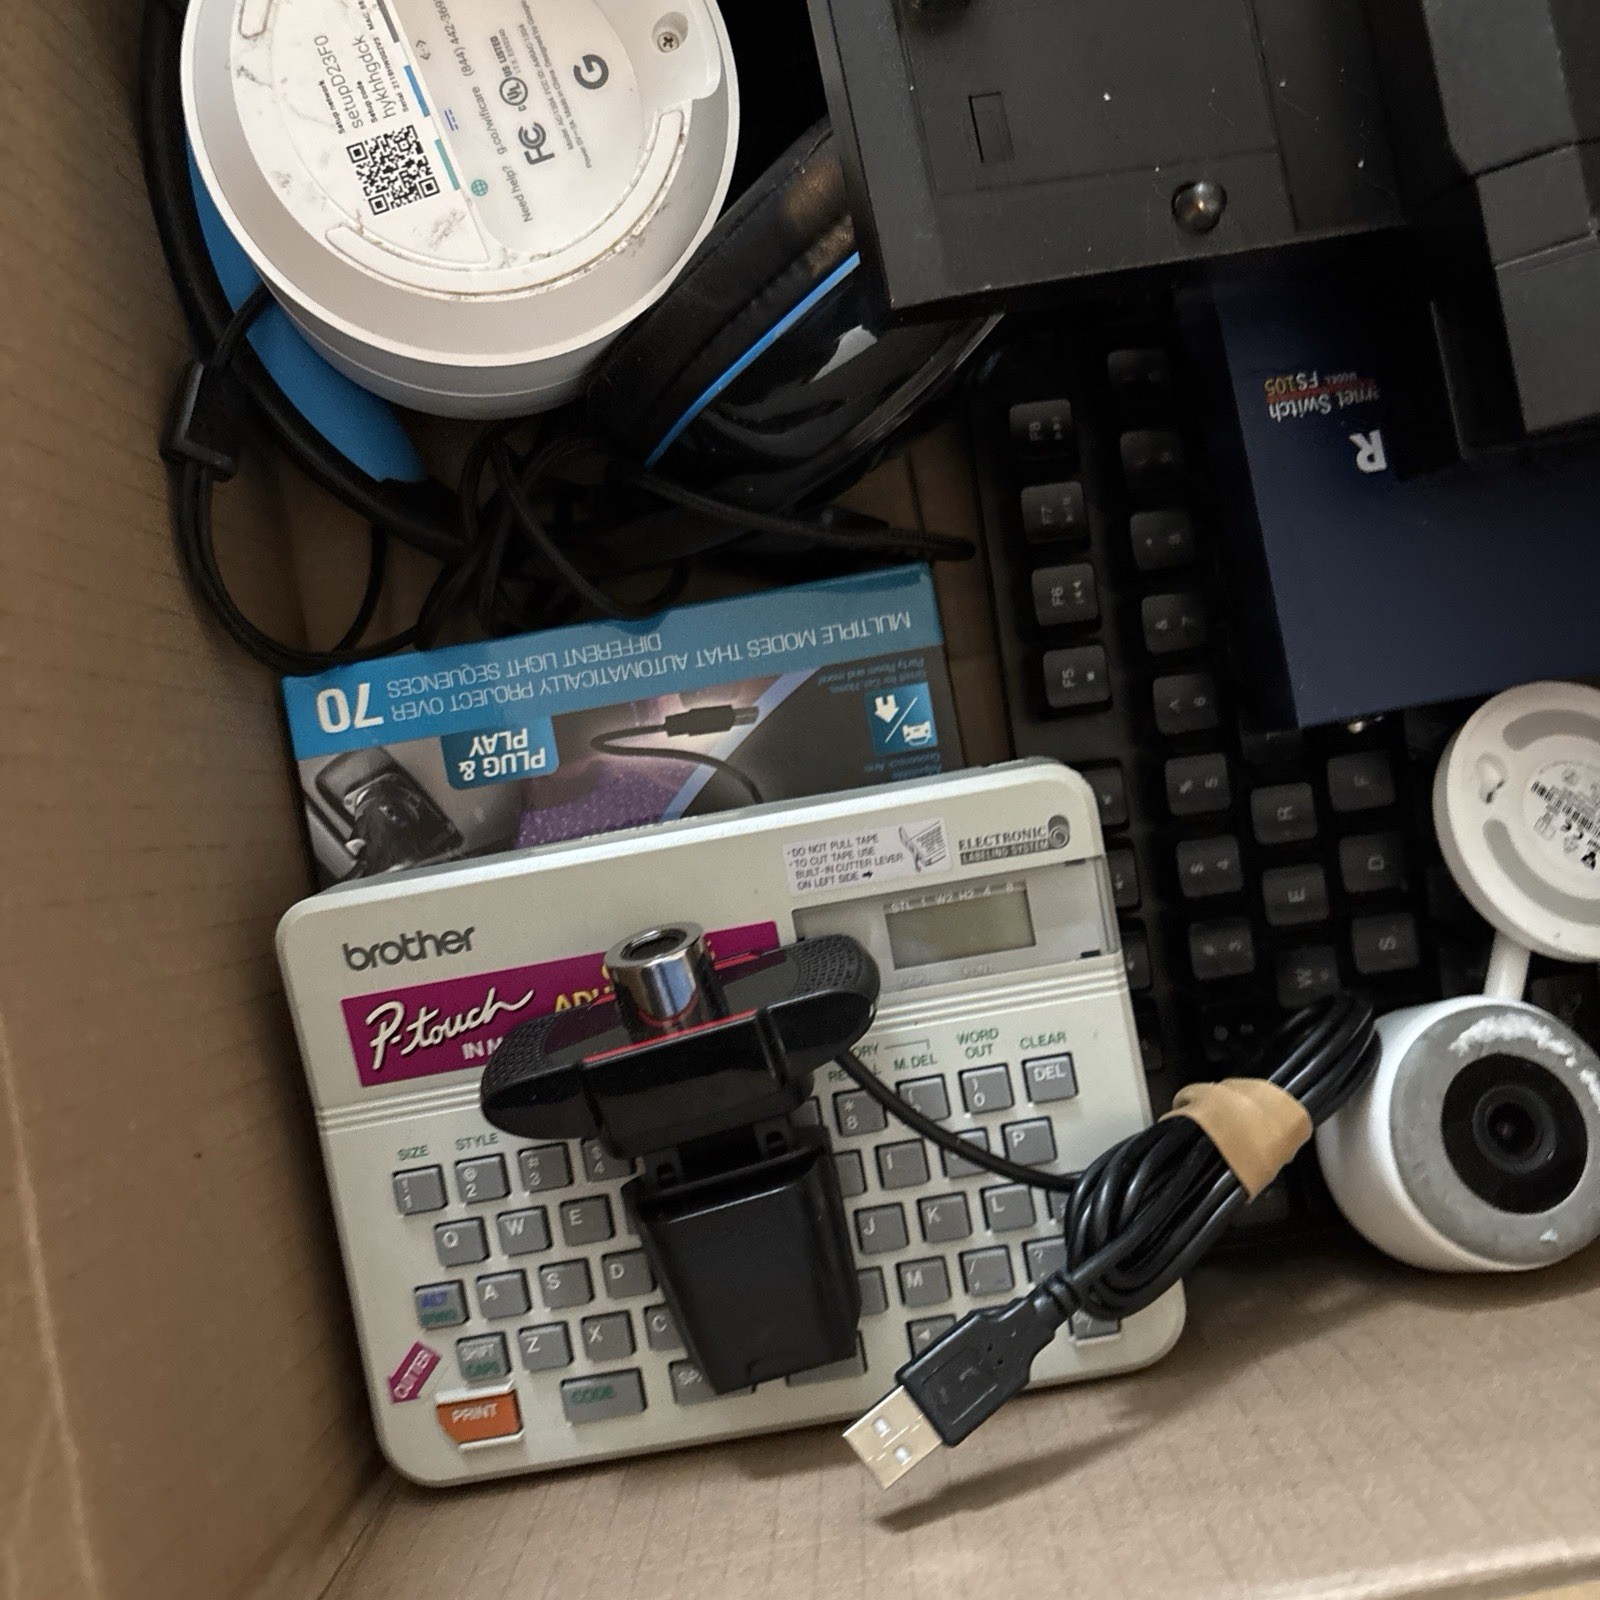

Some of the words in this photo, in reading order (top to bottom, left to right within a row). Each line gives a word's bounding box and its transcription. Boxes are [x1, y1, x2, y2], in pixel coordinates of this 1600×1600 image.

[434, 0, 460, 45] 442-369
[489, 34, 507, 64] LISTED
[454, 46, 475, 77] (844)
[314, 35, 363, 129] setupD23F0
[353, 35, 397, 119] hykhhgdck
[316, 79, 336, 112] network
[354, 80, 368, 100] code
[363, 99, 378, 123] Setup
[471, 86, 507, 155] g.co/wificare
[330, 112, 346, 135] Setup
[502, 164, 521, 192] help?
[514, 194, 533, 223] Need
[1267, 392, 1333, 424] Switch
[1349, 429, 1388, 474] R
[819, 610, 911, 644] MULTIPLE
[560, 632, 662, 667] DIFFERENT
[745, 627, 817, 658] MODES
[503, 651, 558, 678] LIGHT
[692, 641, 743, 668] THAT
[384, 657, 501, 698] SEQUENCES
[537, 652, 690, 696] AUTOMATICALLY
[1061, 667, 1076, 688] F5
[447, 680, 534, 712] PROJECT
[317, 681, 383, 735] 70
[390, 696, 444, 722] OVER
[466, 727, 530, 757] PLAY
[457, 759, 478, 781] &
[480, 747, 547, 778] PLUG
[1275, 804, 1294, 821] R
[808, 843, 828, 854] NOT
[830, 840, 854, 850] PULL
[856, 834, 878, 845] TAPE
[958, 826, 1047, 852] ELECTRONIC
[795, 864, 834, 880] BUILT-IN
[836, 858, 872, 872] CUTTER
[874, 852, 904, 866] LEVER
[810, 854, 828, 866] CUT
[832, 850, 854, 862] TAPE
[857, 846, 876, 858] USE
[1366, 853, 1385, 872] D
[814, 876, 835, 888] LEFT
[838, 872, 860, 884] SIDE
[1286, 886, 1306, 903] E
[342, 926, 475, 971] brother
[365, 986, 536, 1072] P-touch
[956, 1027, 1000, 1046] WORD
[966, 1043, 994, 1059] OUT
[1020, 1031, 1067, 1050] CLEAR
[894, 1055, 938, 1071] M.DEL
[1034, 1064, 1067, 1082] DEL
[454, 1132, 499, 1152] STYLE
[1012, 1130, 1025, 1147] P
[397, 1145, 430, 1162] SIZE
[466, 1184, 478, 1198] 2
[926, 1207, 942, 1224] K
[991, 1196, 1006, 1214] L
[505, 1217, 526, 1236] W
[569, 1209, 582, 1226] E
[863, 1216, 876, 1235] J
[546, 1274, 561, 1290] S
[610, 1264, 625, 1280] D
[905, 1270, 924, 1289] M
[484, 1284, 500, 1300] A
[652, 1315, 667, 1332] C
[526, 1336, 541, 1354] Z
[588, 1326, 602, 1344] X
[451, 1402, 498, 1424] PRINT
